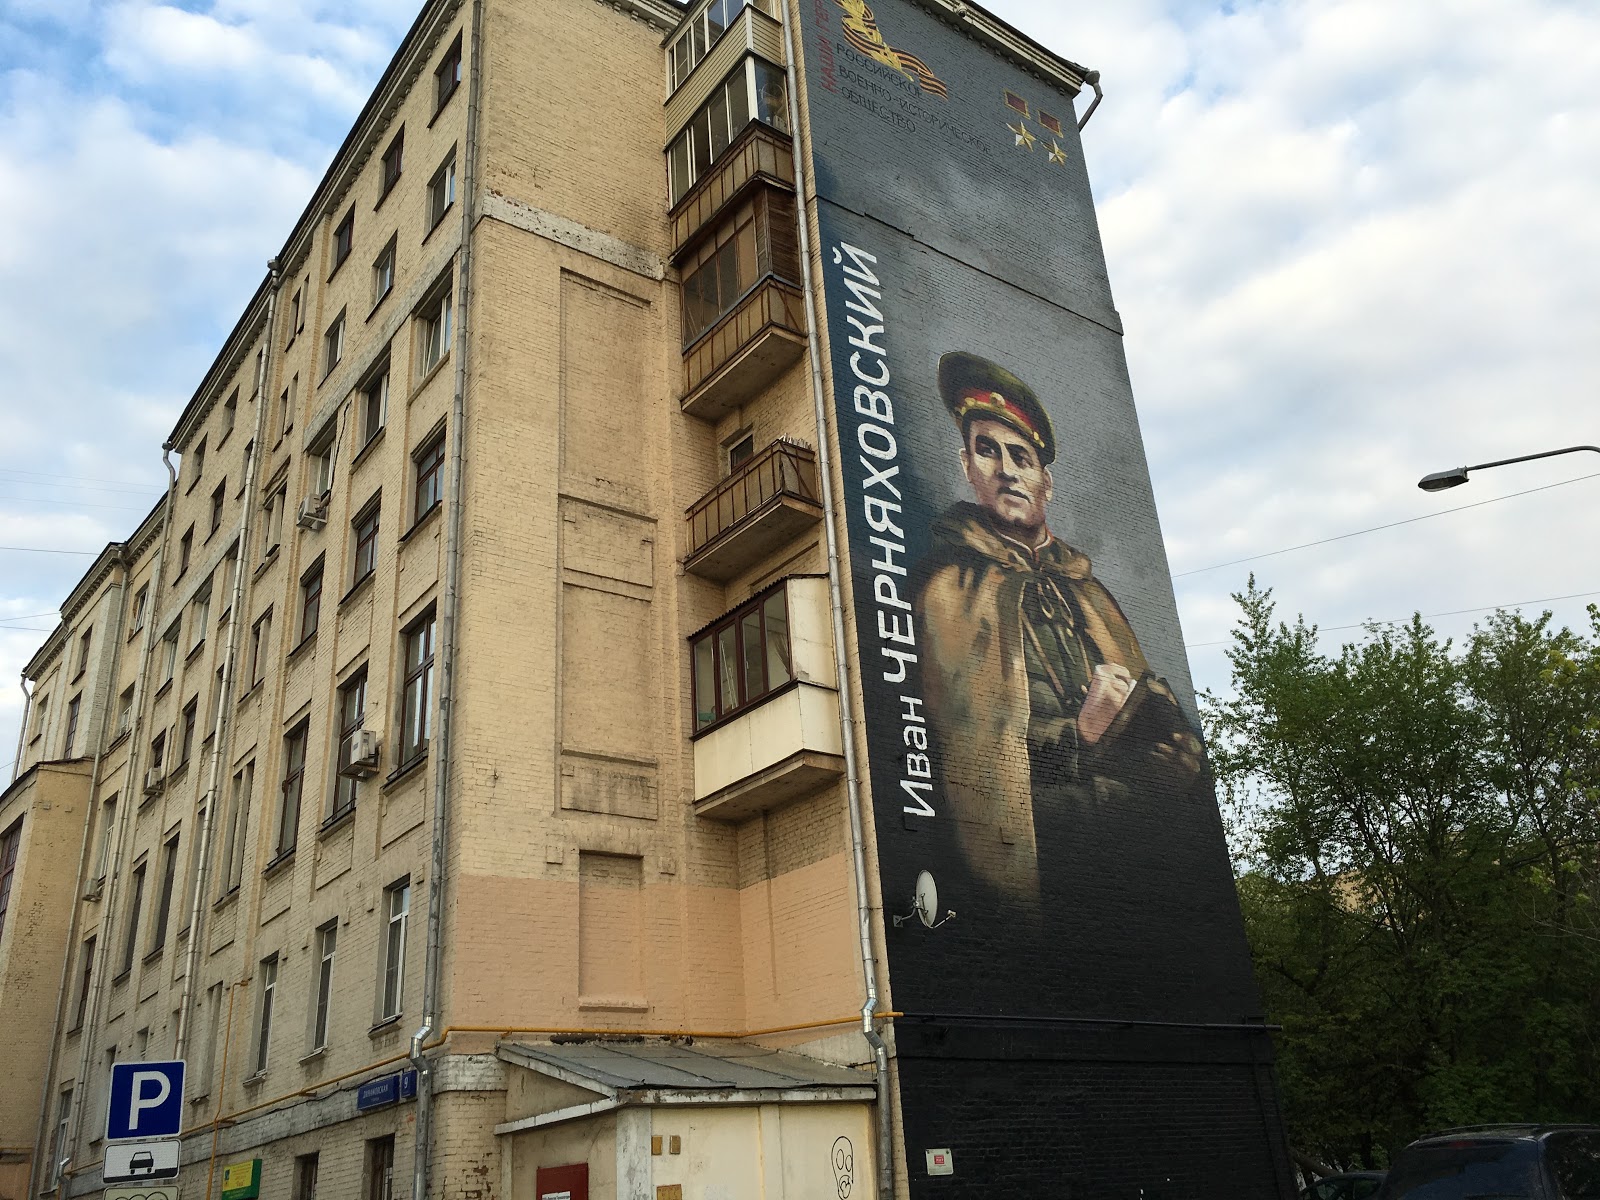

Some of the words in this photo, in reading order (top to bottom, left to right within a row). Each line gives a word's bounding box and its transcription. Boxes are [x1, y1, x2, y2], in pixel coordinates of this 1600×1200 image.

[836, 43, 922, 98] РОССИЙСКОЕ
[841, 86, 916, 134] ОБЩЕСТВО
[832, 241, 918, 684] ЧЕРНЯХОВСКИЙ
[900, 695, 936, 818] Иван
[129, 1071, 171, 1131] P
